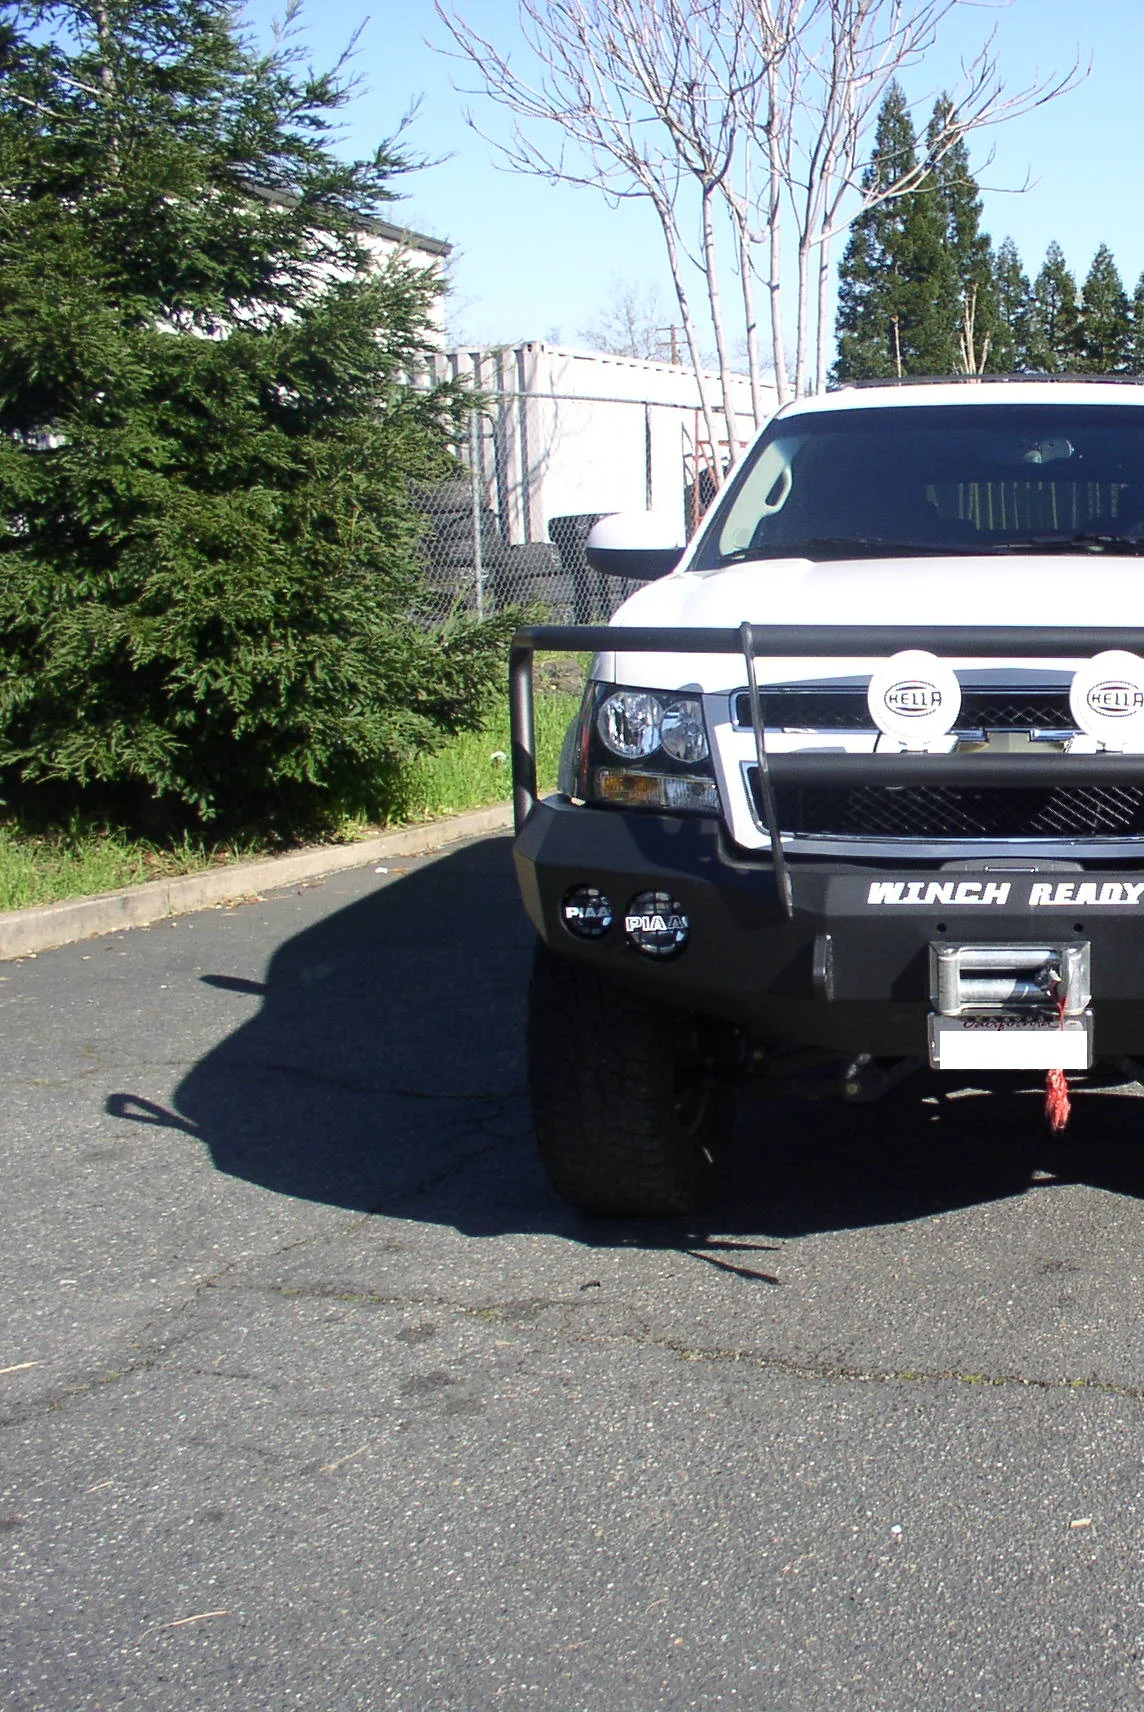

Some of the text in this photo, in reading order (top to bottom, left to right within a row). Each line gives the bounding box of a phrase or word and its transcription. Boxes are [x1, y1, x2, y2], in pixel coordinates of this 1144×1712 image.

[888, 691, 943, 707] HELLA
[1091, 691, 1144, 707] HELLA
[867, 881, 1012, 905] WINCH
[565, 906, 611, 919] PIAA
[625, 915, 686, 932] PIAA
